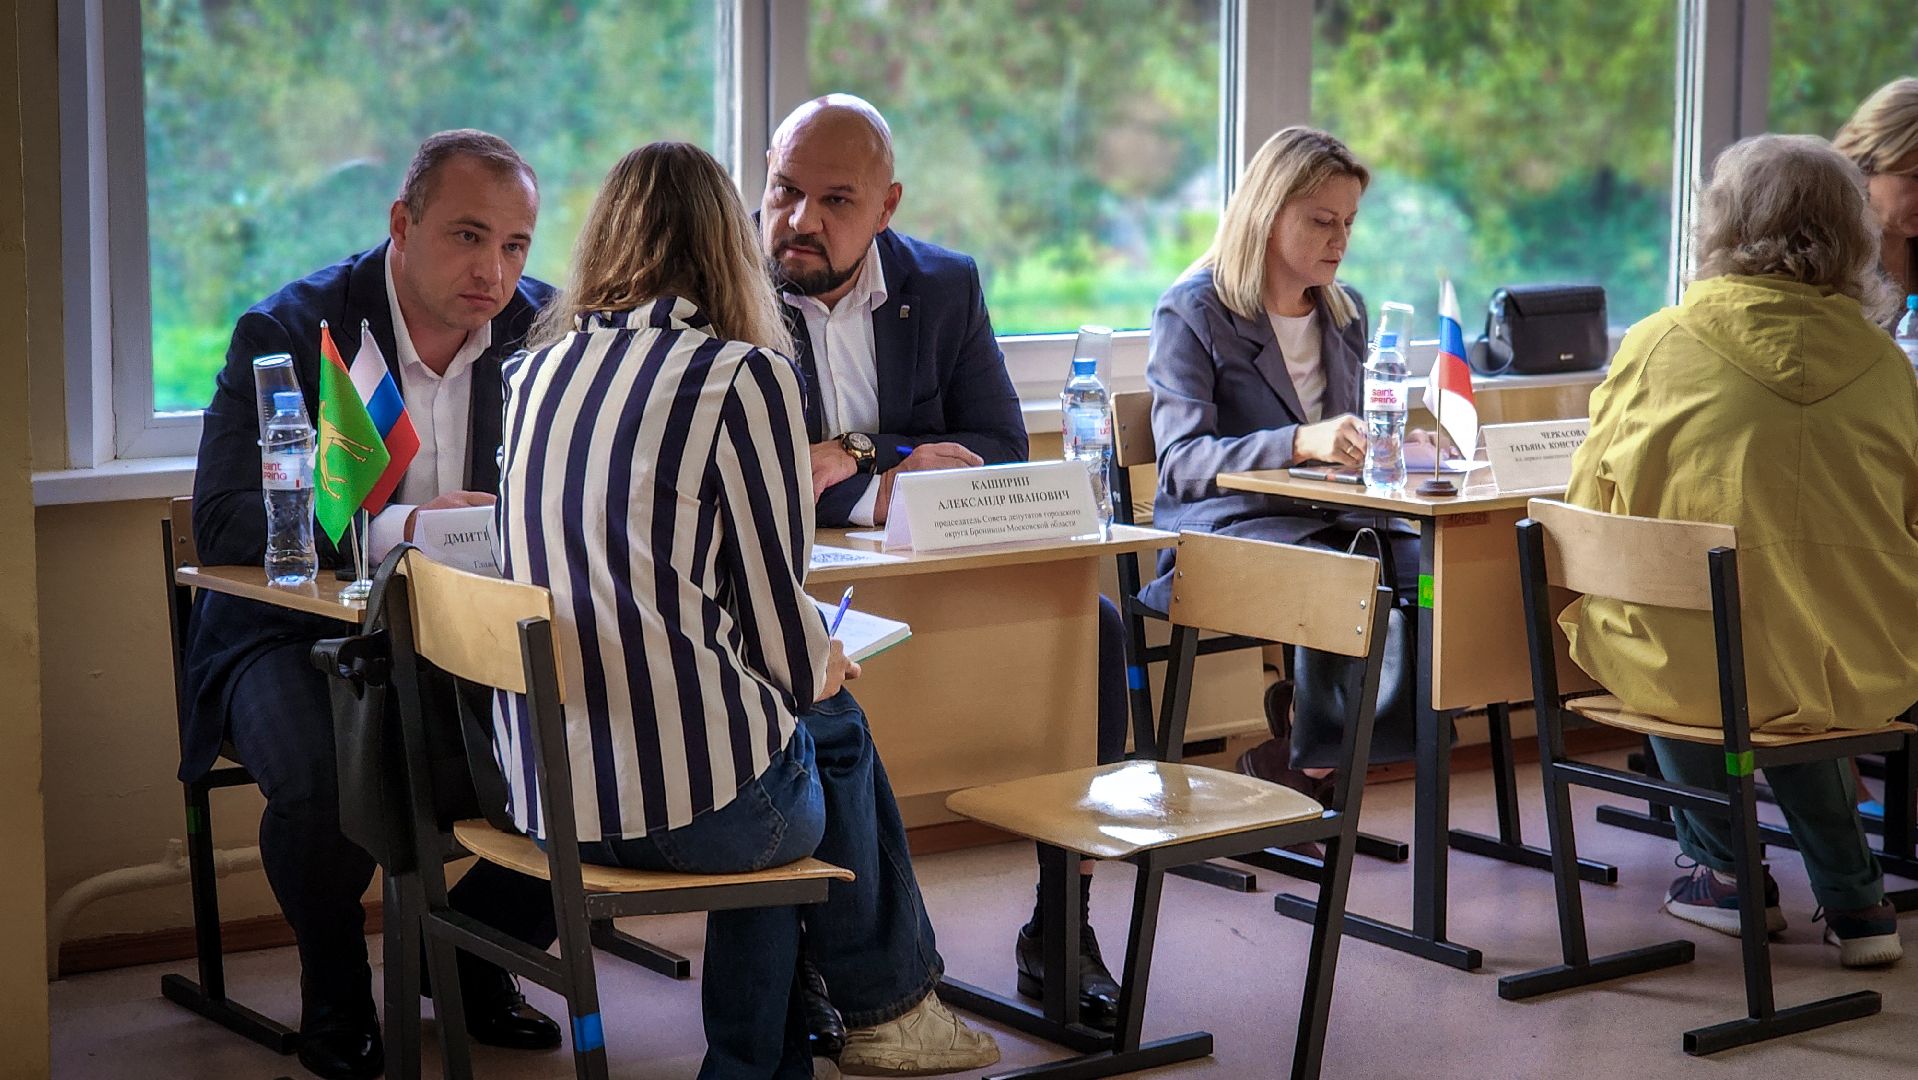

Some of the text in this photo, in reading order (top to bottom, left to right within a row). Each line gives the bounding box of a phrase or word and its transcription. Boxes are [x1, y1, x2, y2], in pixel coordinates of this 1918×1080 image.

[1541, 429, 1587, 439] ЧЕРКАСОВА
[1510, 443, 1546, 452] ТАТЬЯНА
[263, 471, 288, 481] PRING
[971, 476, 1031, 491] КАШИРИН
[938, 489, 1070, 511] АЛЕКСАНДР ИВАНОВИЧ
[934, 509, 1081, 528] председатель Совета депутатов городского
[944, 530, 969, 540] округа
[1006, 521, 1049, 532] Московской
[1050, 520, 1076, 528] области
